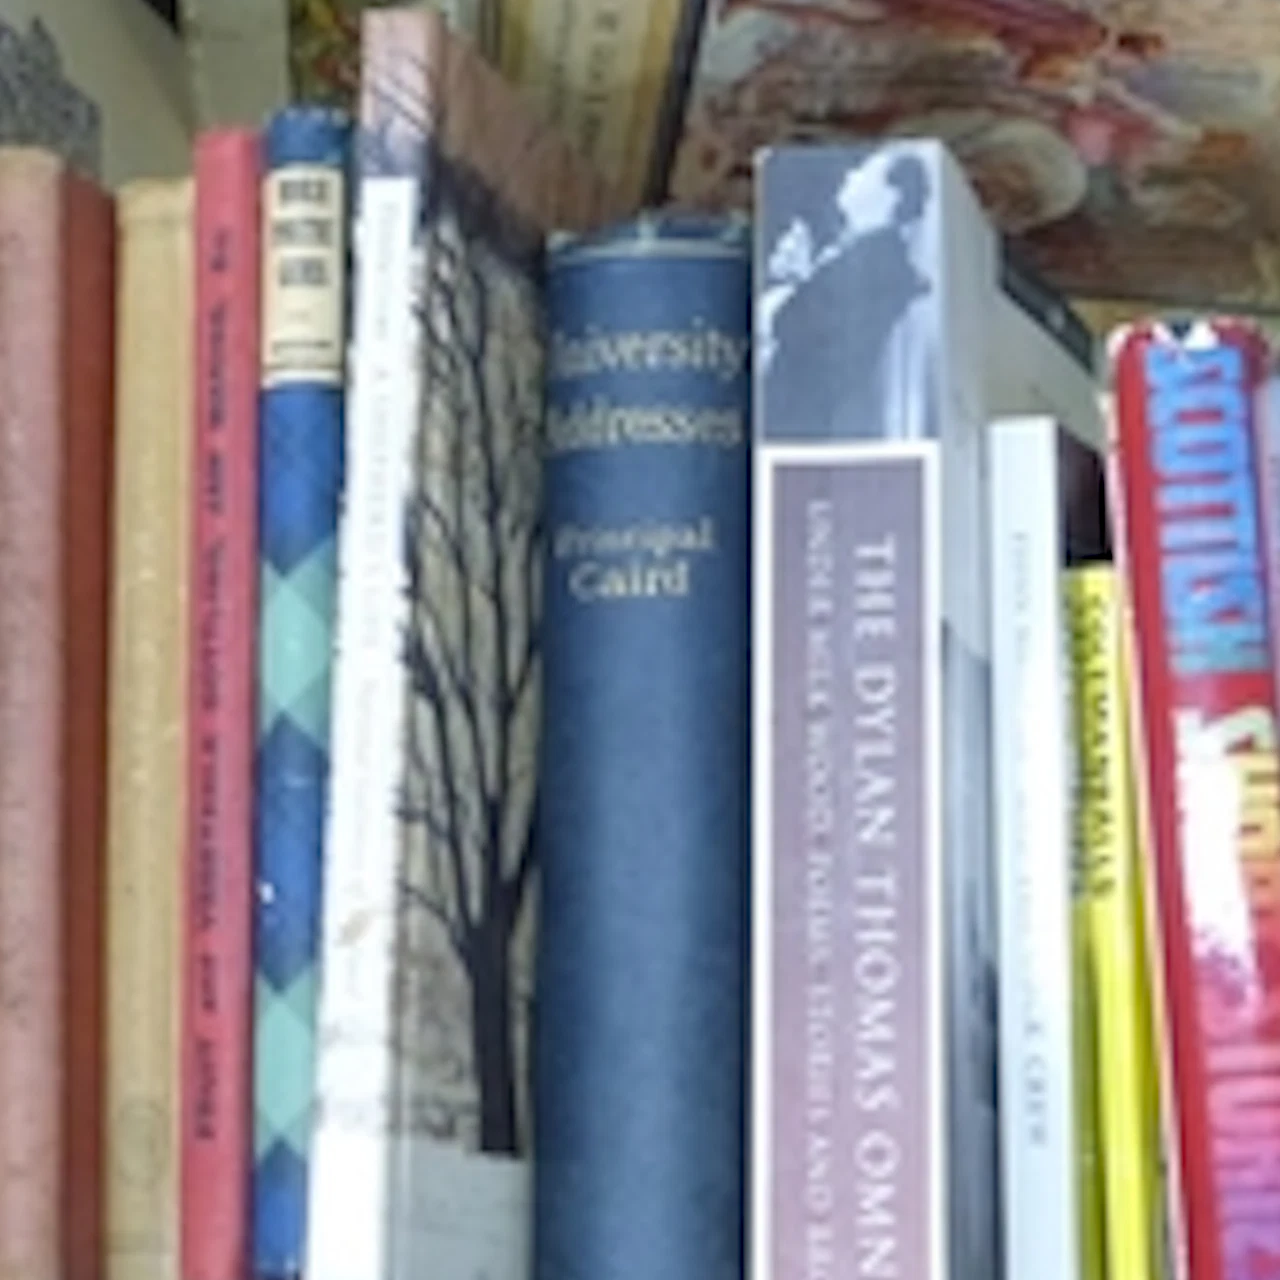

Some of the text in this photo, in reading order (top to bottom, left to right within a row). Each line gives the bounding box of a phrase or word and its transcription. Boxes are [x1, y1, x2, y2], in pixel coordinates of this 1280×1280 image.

[570, 562, 690, 603] Caird
[1145, 342, 1271, 678] SCOTTISH
[852, 533, 899, 641] THE
[851, 661, 901, 848] DYLAN
[852, 867, 903, 1111] THOMAS
[804, 1131, 836, 1214] AND
